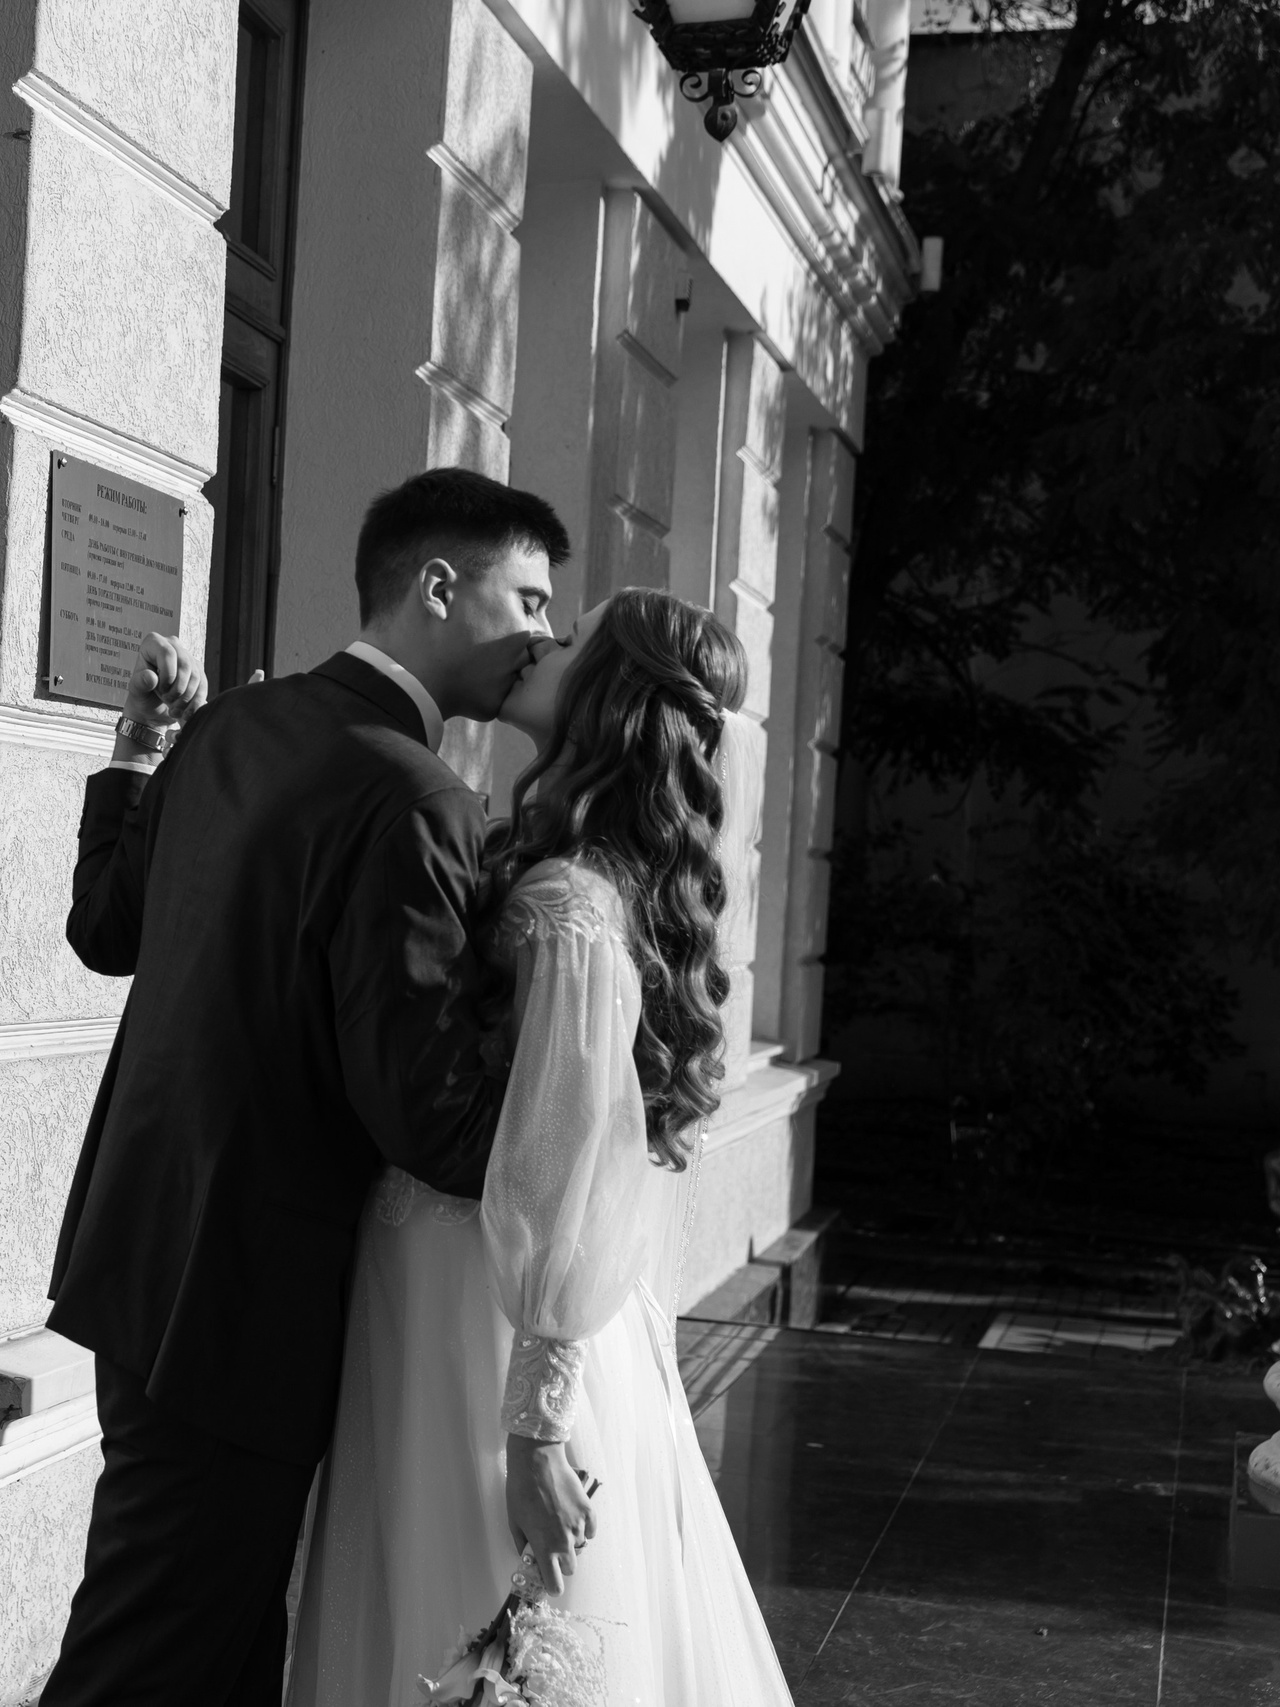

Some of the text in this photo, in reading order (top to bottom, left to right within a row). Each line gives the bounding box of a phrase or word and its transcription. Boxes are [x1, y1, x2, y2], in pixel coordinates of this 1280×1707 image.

[97, 484, 147, 514] РЕЖИМ РАБОТЫ:
[62, 499, 81, 513] ВТОРНИК
[62, 512, 79, 525] ЧЕТВЕРГ
[61, 529, 75, 542] СРЕДА
[100, 542, 115, 555] РАБОТЫ
[61, 562, 80, 575] ПЯТНИЦА
[60, 609, 78, 622] СУББОТА
